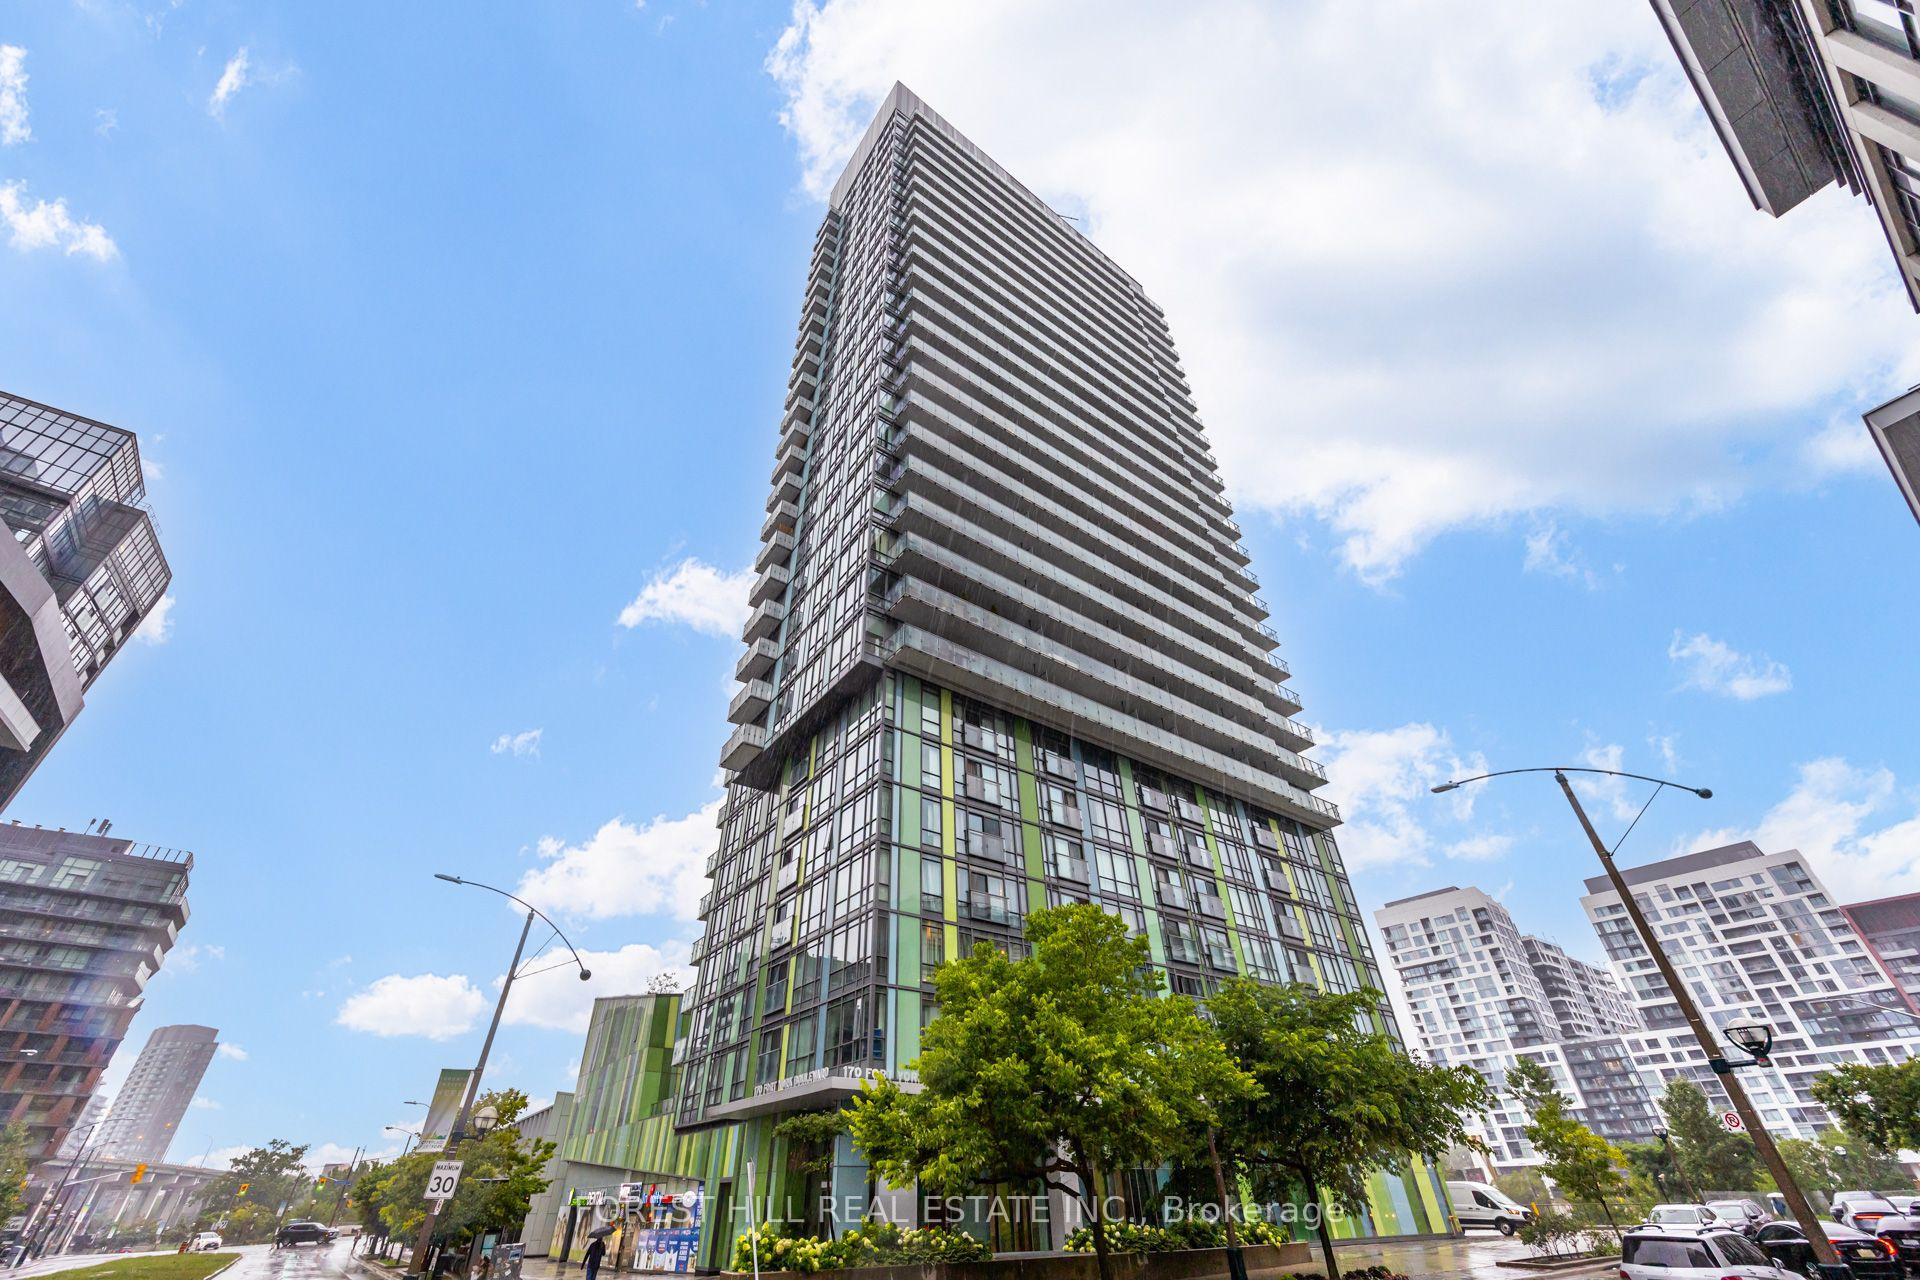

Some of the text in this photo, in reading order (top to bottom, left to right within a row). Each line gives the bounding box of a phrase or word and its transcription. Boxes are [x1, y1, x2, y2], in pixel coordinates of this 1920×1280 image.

[843, 1065, 862, 1079] 170
[897, 1069, 920, 1083] YOR
[436, 1163, 460, 1172] MAXIMUM
[430, 1176, 454, 1194] 30
